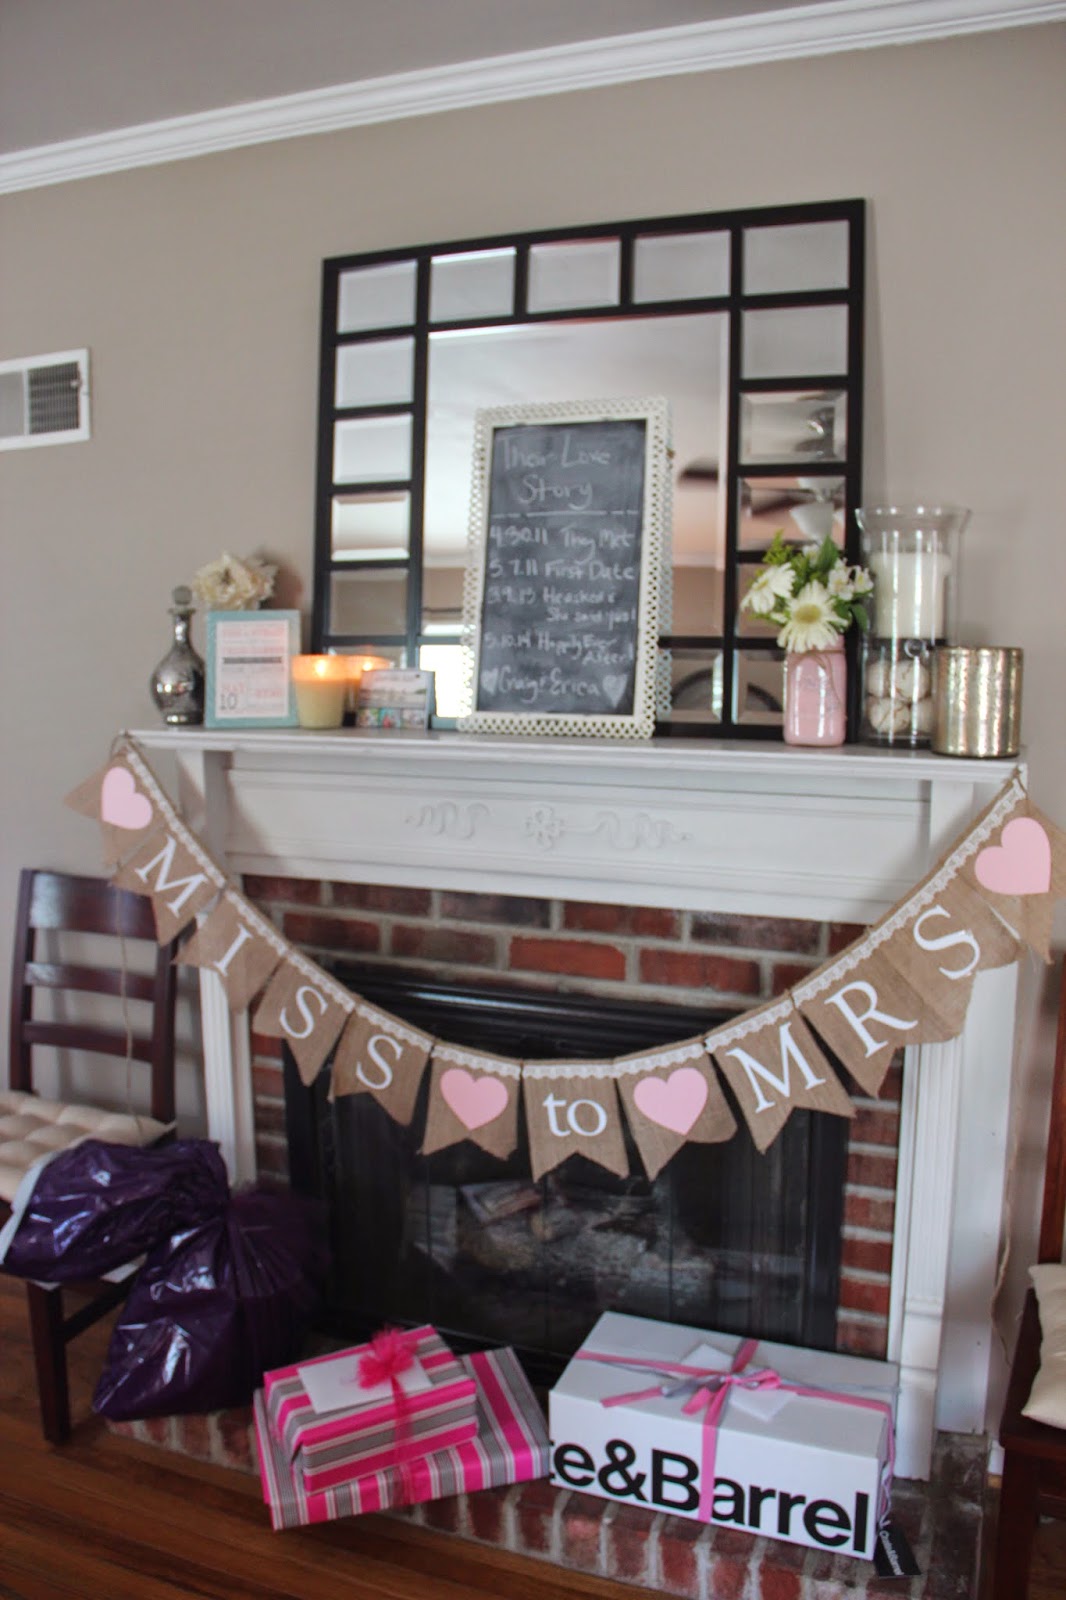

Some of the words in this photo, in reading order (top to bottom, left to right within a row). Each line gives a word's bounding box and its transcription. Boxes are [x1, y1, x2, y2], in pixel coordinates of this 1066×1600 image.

[562, 434, 612, 469] Love
[517, 474, 593, 510] Story
[589, 560, 636, 581] Date
[550, 667, 600, 696] Erica
[135, 833, 404, 1091] MISS
[541, 1092, 608, 1138] to
[725, 904, 981, 1116] MRS
[549, 1438, 870, 1554] e&Barrel
